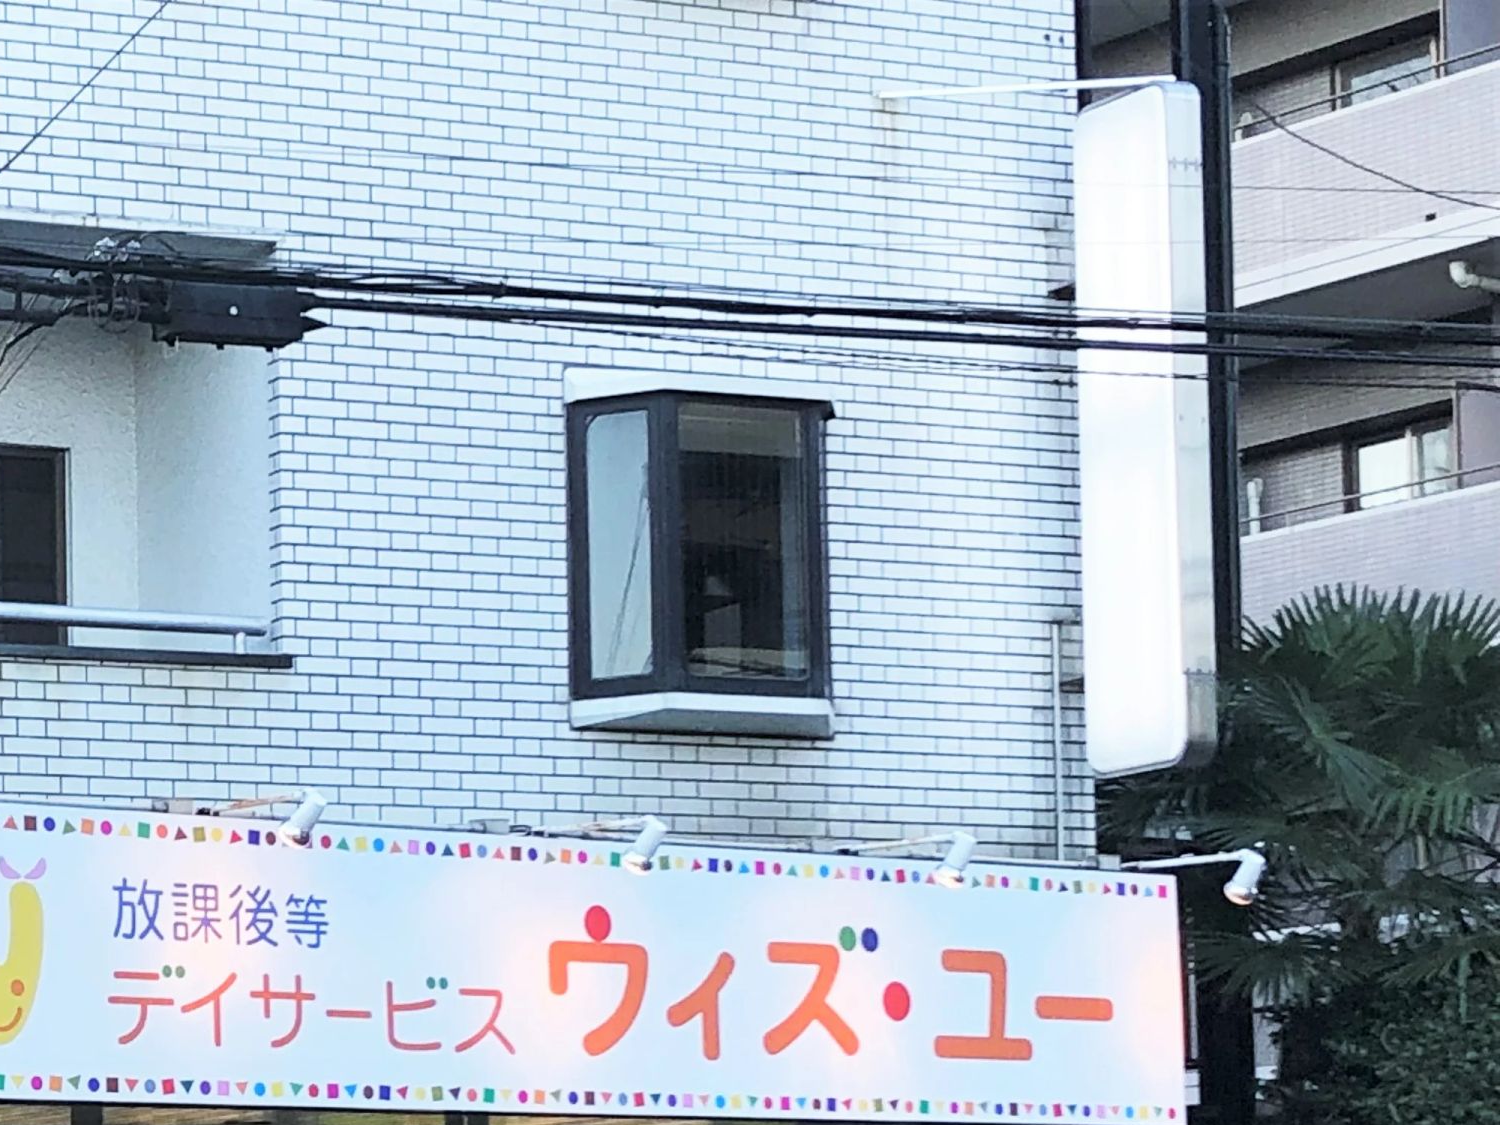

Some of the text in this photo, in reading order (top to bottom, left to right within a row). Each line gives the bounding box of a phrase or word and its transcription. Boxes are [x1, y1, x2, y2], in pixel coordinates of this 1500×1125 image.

[112, 876, 329, 950] 放課後等
[107, 963, 516, 1055] デイサービス
[547, 903, 1114, 1061] ウィズ・ユー
